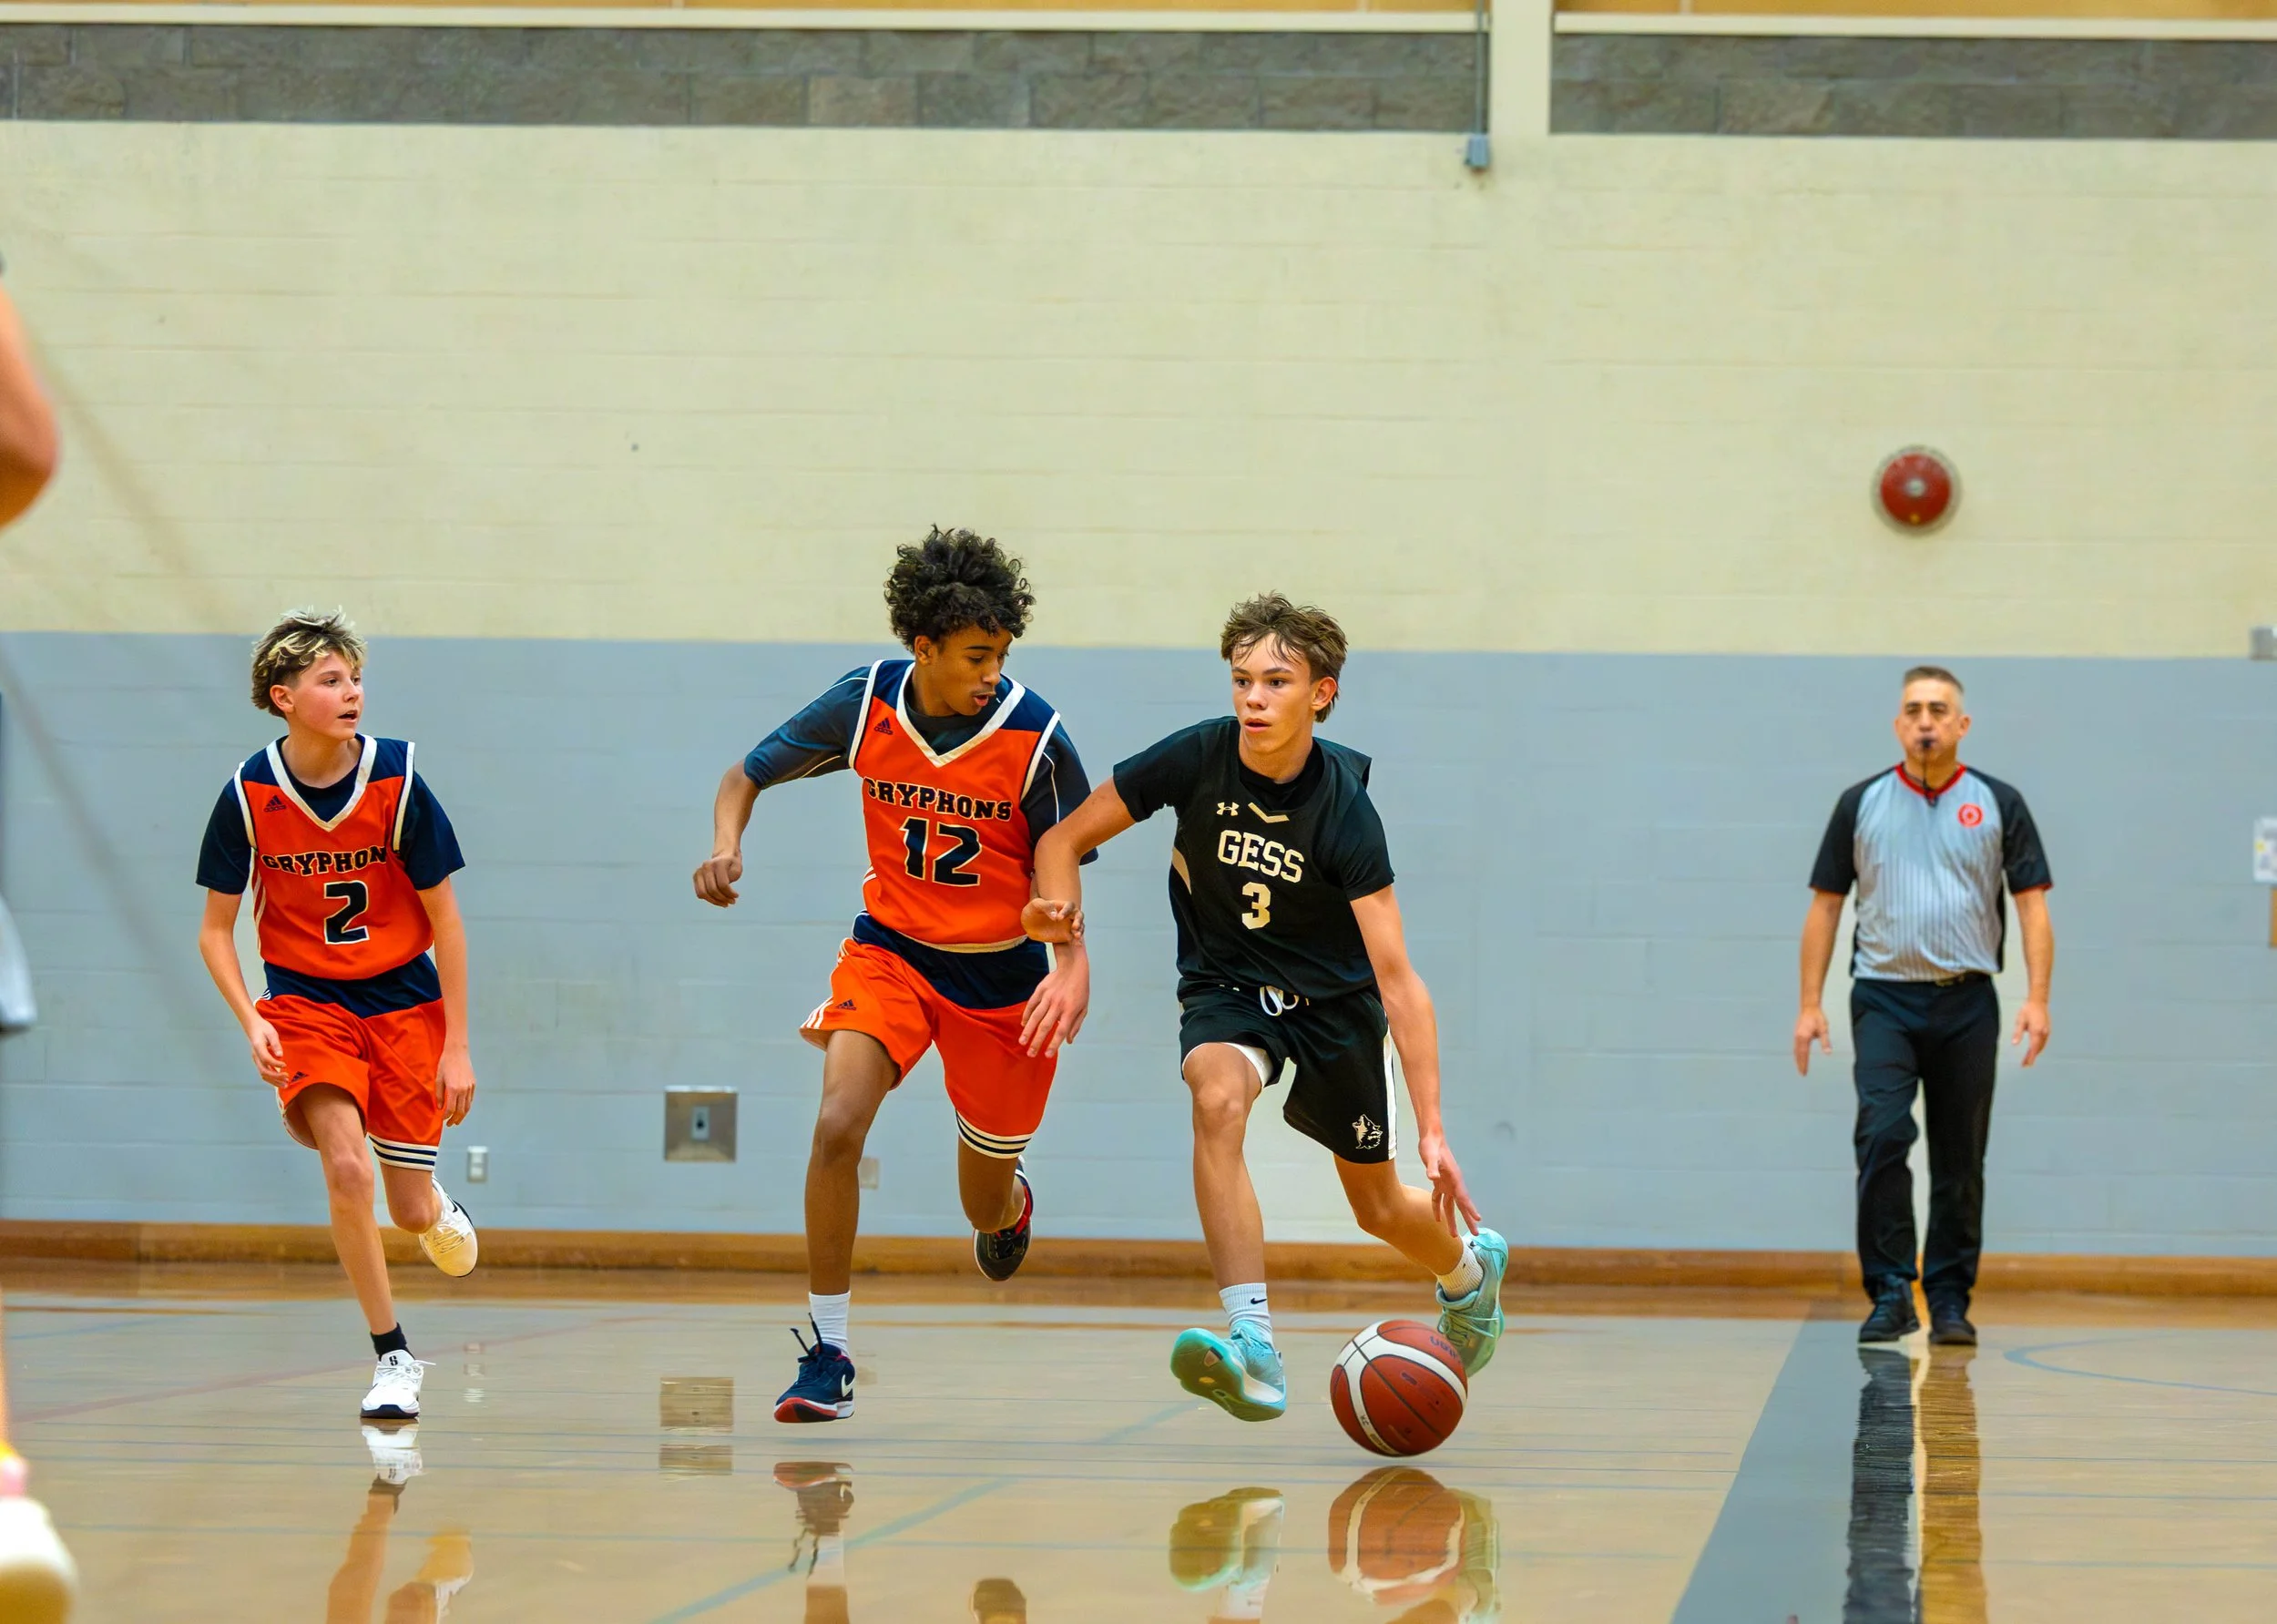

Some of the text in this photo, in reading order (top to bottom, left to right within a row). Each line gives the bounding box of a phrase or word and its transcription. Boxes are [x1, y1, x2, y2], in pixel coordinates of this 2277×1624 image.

[899, 816, 982, 887] 12
[1217, 830, 1305, 883] GESS
[323, 880, 370, 945] 2
[1241, 882, 1271, 930] 3
